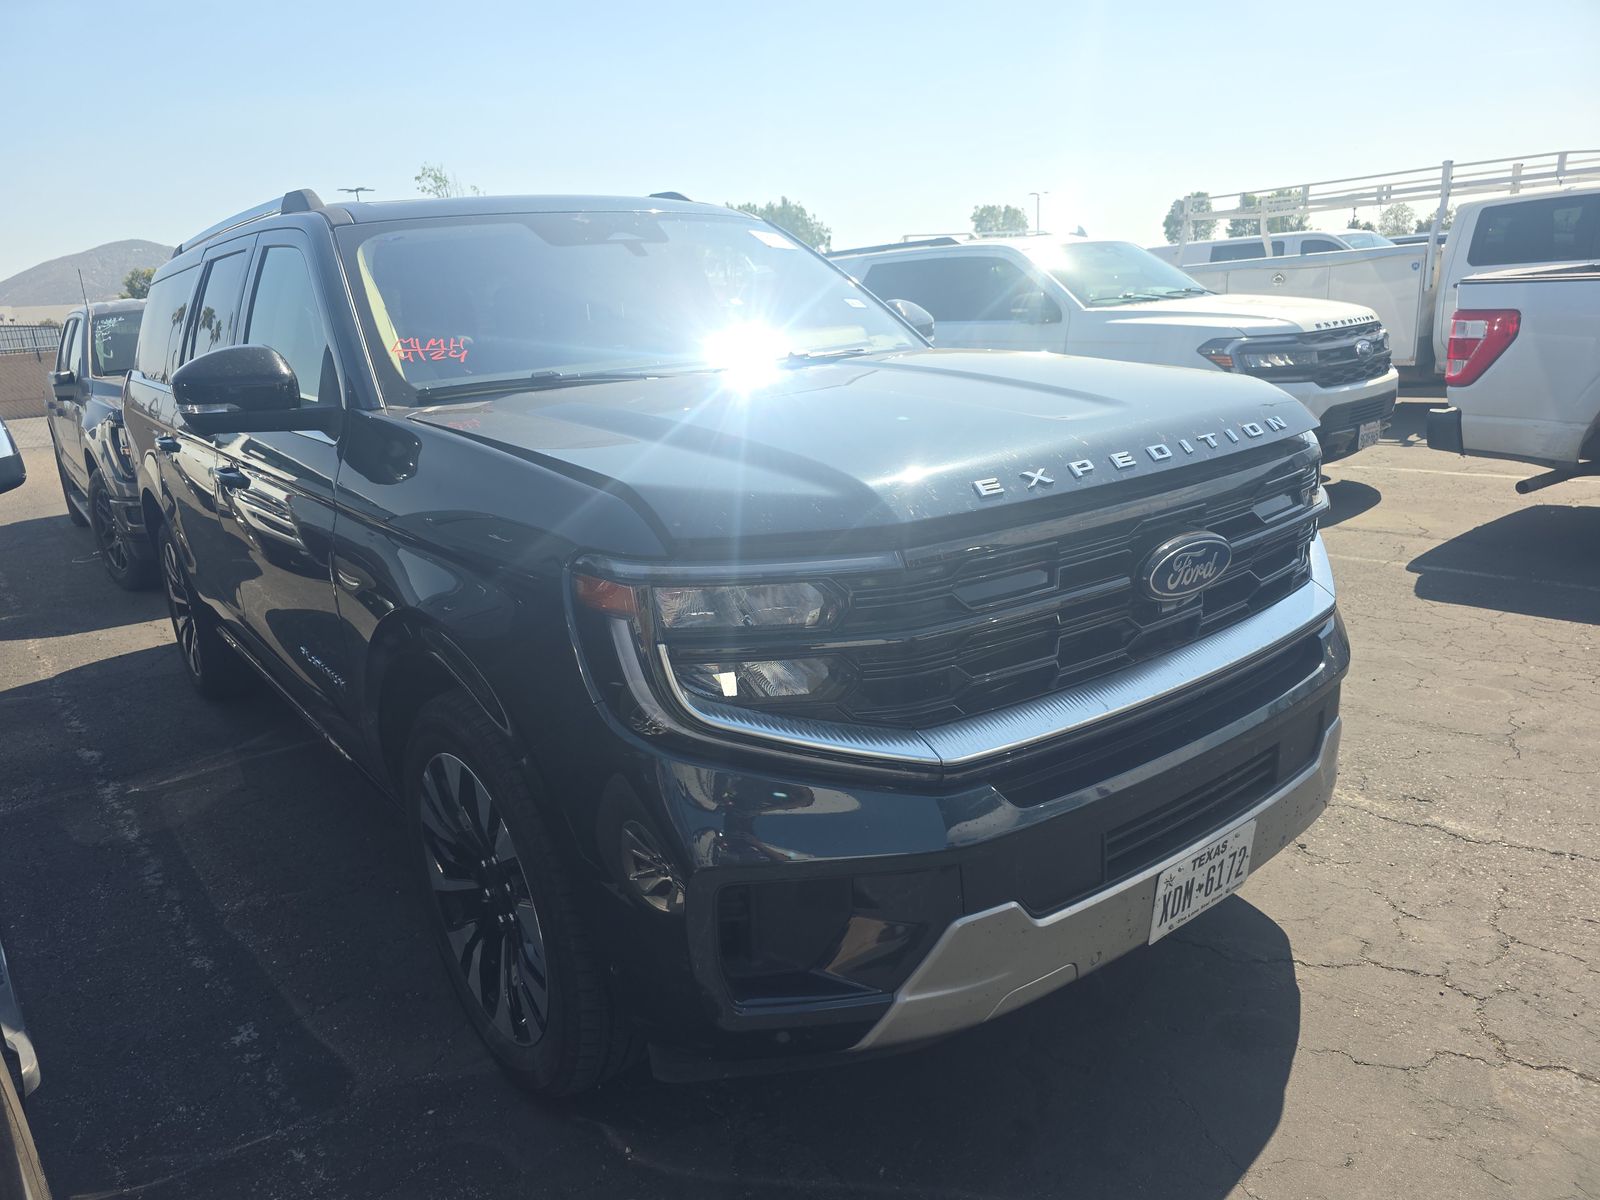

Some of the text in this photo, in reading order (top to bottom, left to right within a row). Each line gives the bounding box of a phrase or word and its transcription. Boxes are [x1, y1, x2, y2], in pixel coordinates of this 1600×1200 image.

[1314, 315, 1375, 329] EXPEDITION
[972, 415, 1288, 498] EXPEDITION
[1167, 548, 1218, 590] Ford
[1191, 840, 1229, 871] TEXAS
